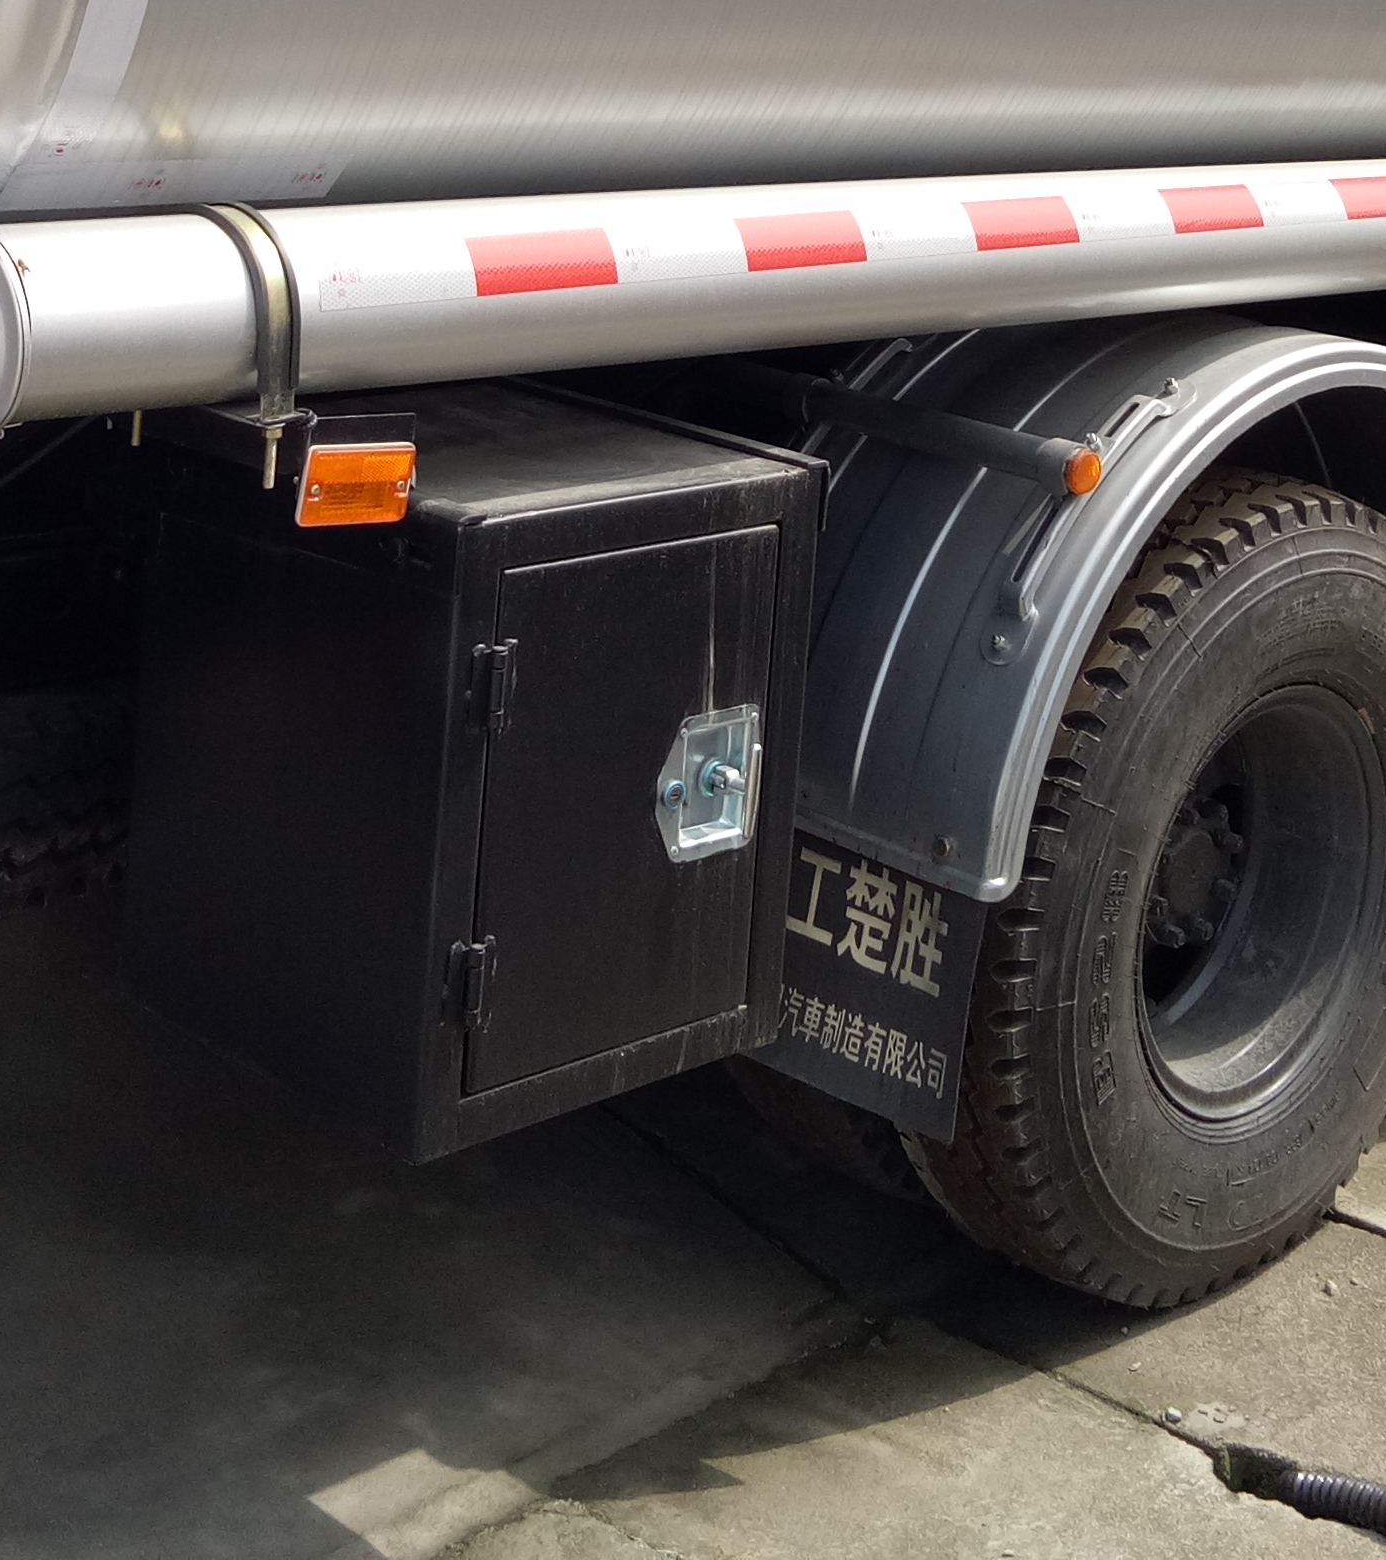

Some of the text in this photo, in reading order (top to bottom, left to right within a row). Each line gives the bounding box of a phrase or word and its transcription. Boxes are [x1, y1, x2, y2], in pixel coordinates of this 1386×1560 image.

[778, 983, 948, 1100] 汽車制造有限公司
